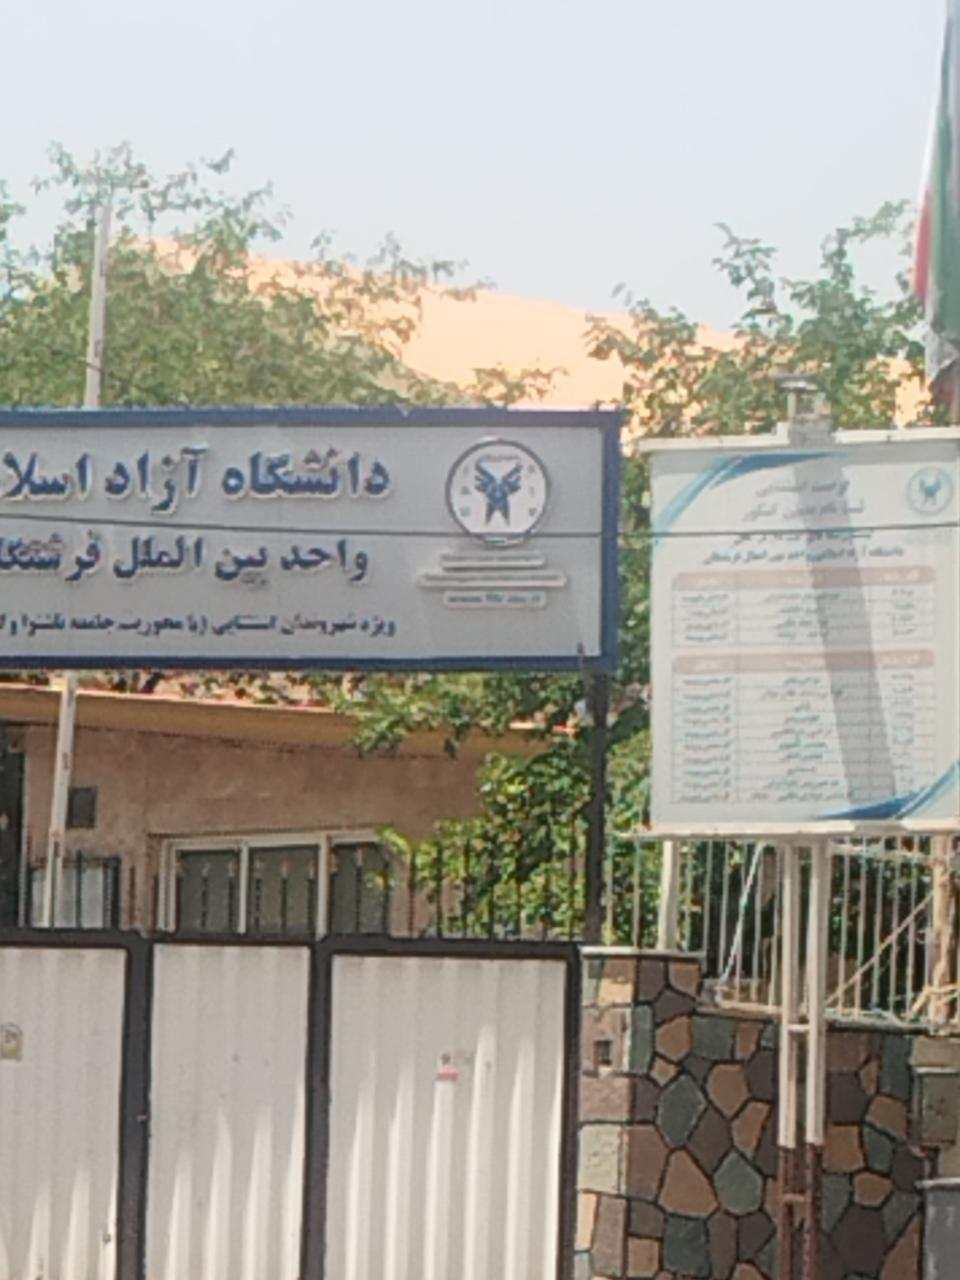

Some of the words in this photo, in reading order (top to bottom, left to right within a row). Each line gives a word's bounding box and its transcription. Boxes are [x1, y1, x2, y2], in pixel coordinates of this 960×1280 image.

[104, 447, 208, 512] آزاد
[221, 448, 390, 495] دانشگاه
[214, 547, 269, 585] بین
[281, 538, 369, 582] واحد
